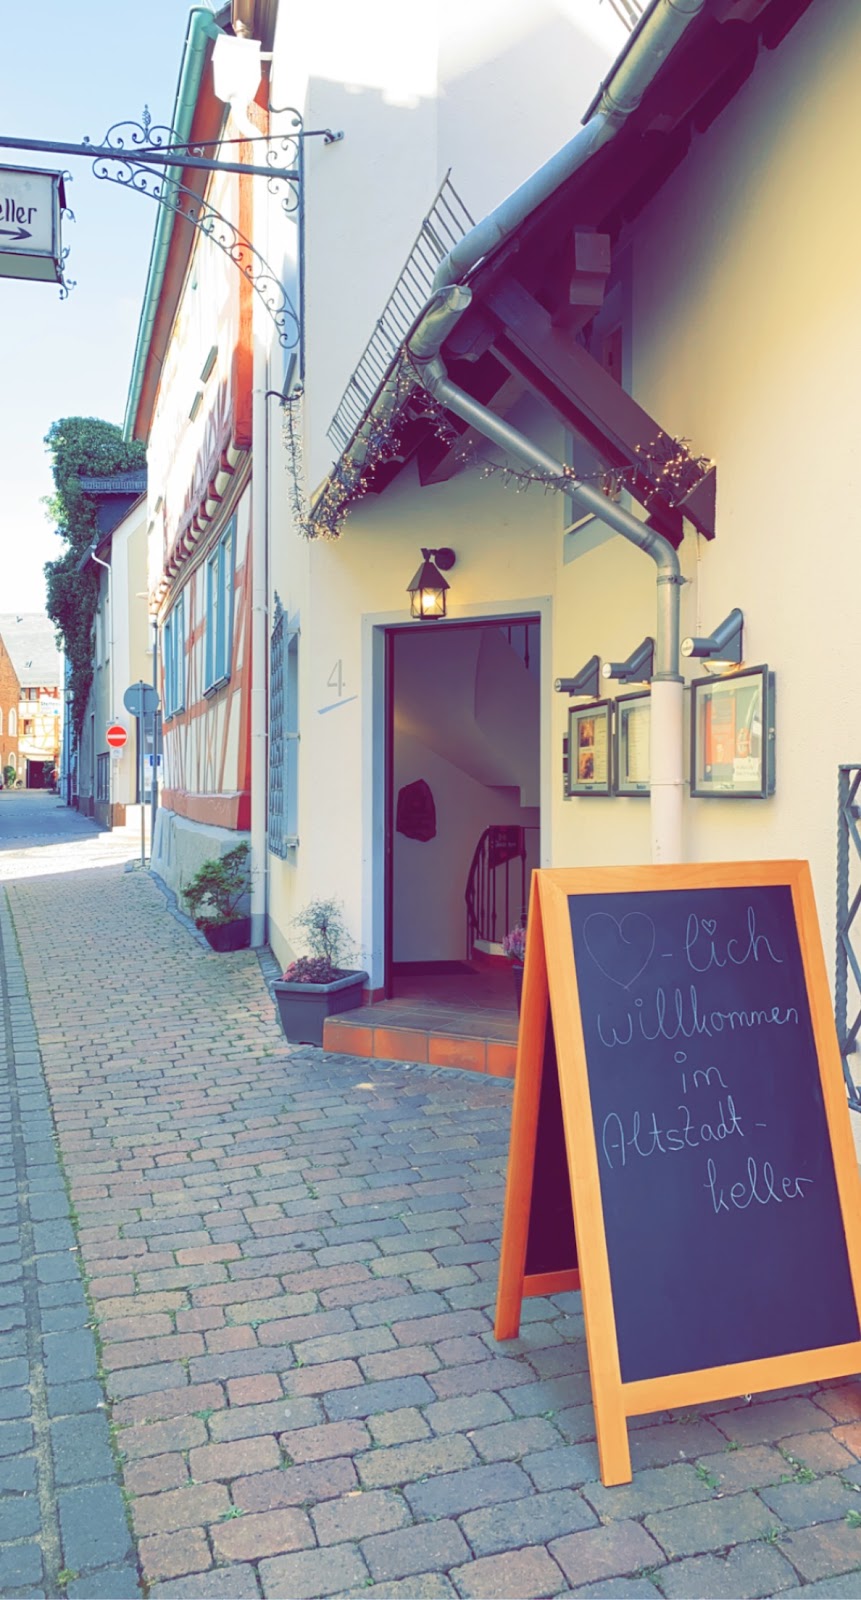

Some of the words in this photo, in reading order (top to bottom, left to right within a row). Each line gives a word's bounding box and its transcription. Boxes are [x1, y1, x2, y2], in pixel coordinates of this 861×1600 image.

[327, 659, 346, 697] 4
[597, 985, 799, 1048] willkommen
[673, 1051, 728, 1094] im
[702, 1157, 814, 1214] keller
